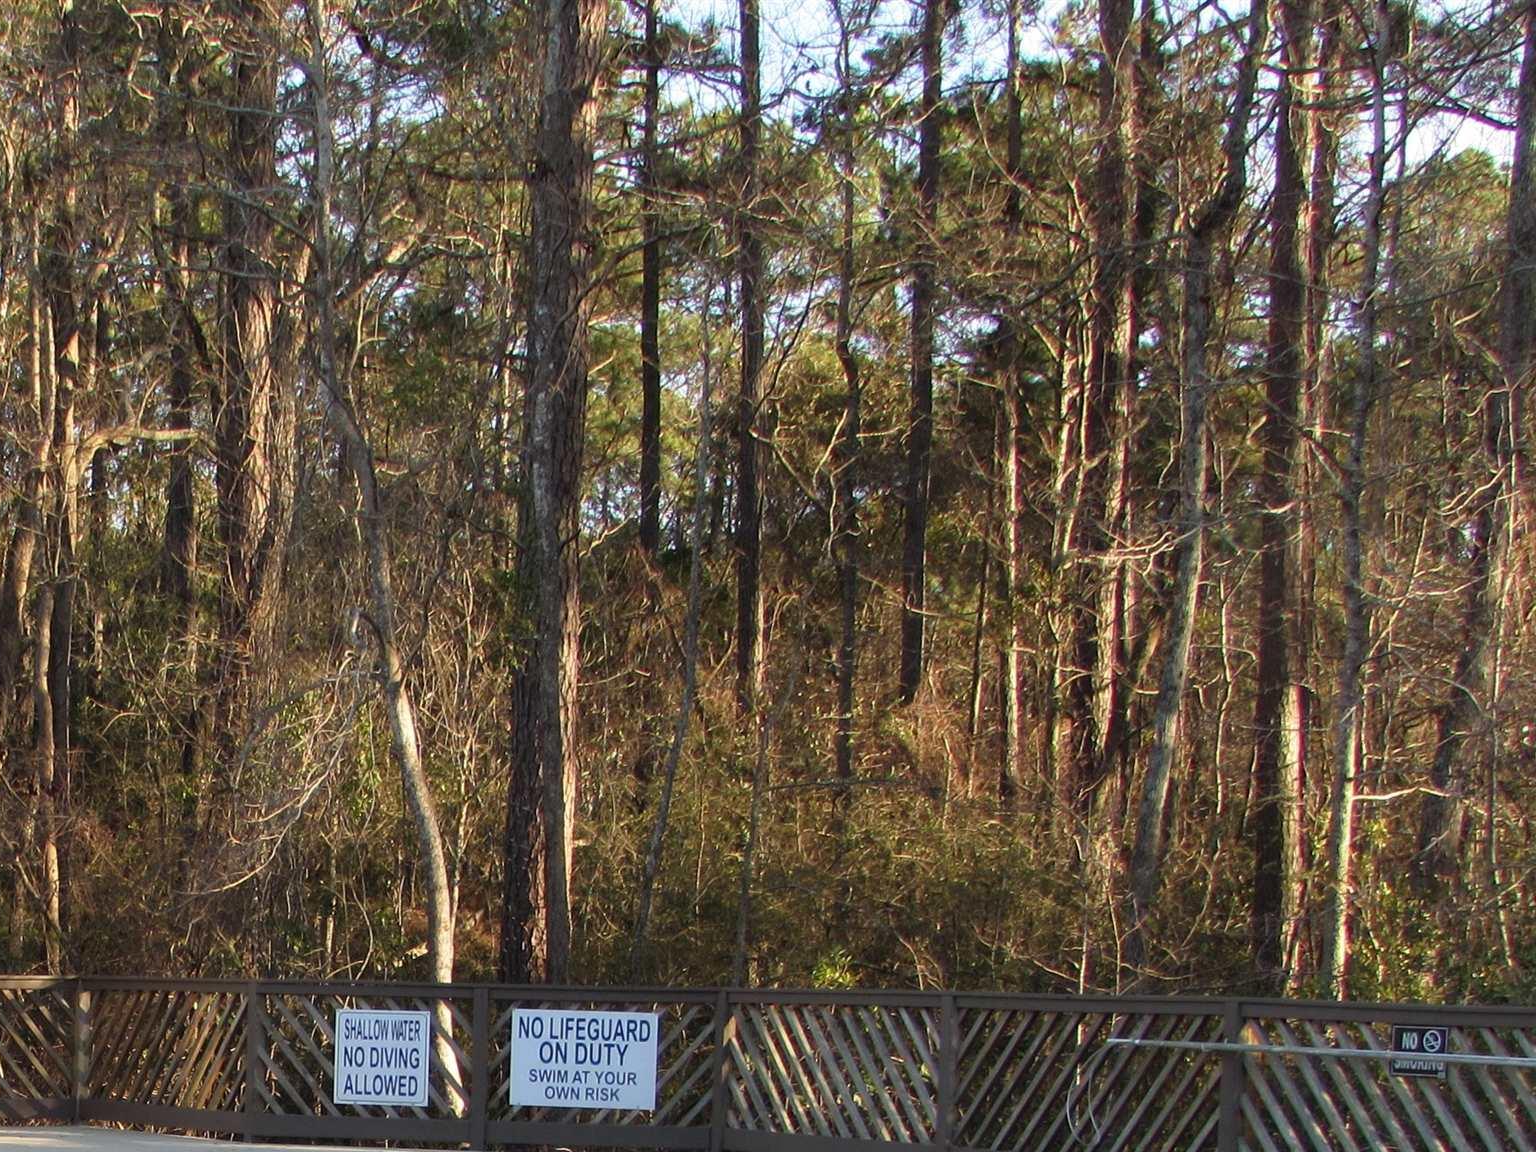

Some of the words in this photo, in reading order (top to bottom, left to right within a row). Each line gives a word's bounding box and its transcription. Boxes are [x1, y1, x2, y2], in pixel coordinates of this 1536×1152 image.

[344, 1018, 389, 1040] SHALLOW
[391, 1020, 421, 1041] WATER
[519, 1016, 544, 1039] NO
[549, 1017, 651, 1042] LIFEGUARD
[1402, 1032, 1418, 1050] NO
[344, 1046, 365, 1068] NO
[369, 1046, 420, 1069] DIVING
[539, 1041, 568, 1065] ON
[575, 1042, 628, 1067] DUTY
[344, 1074, 419, 1097] ALLOWED
[528, 1068, 569, 1083] SWIM
[571, 1071, 591, 1084] AT
[594, 1071, 637, 1086] YOUR
[544, 1086, 581, 1101] OWN
[585, 1087, 621, 1102] RISK
